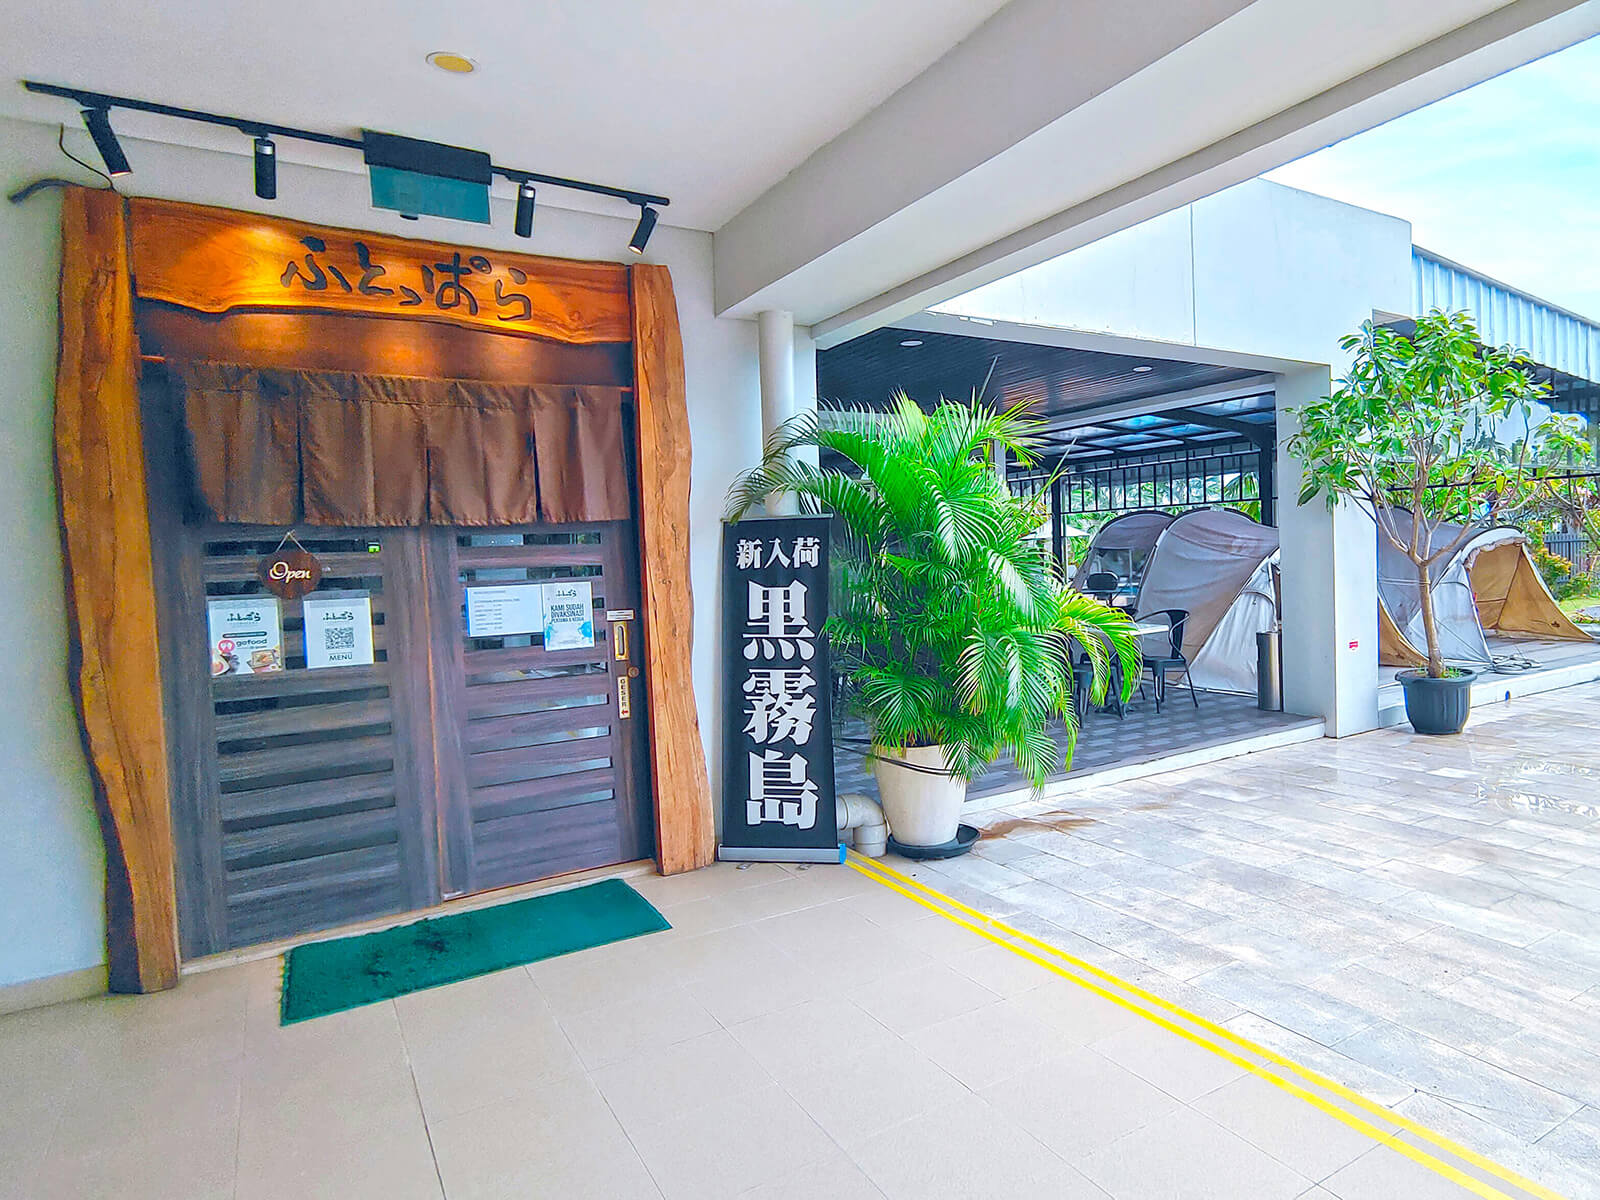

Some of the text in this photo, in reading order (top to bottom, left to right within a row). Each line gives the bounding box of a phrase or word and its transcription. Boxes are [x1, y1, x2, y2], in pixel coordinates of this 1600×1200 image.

[279, 235, 532, 322] ふとっぱら
[736, 537, 822, 570] 新入荷
[269, 561, 311, 583] Open
[566, 603, 584, 611] SUDAH
[329, 653, 353, 662] MENU
[742, 577, 819, 830] 黒霧島
